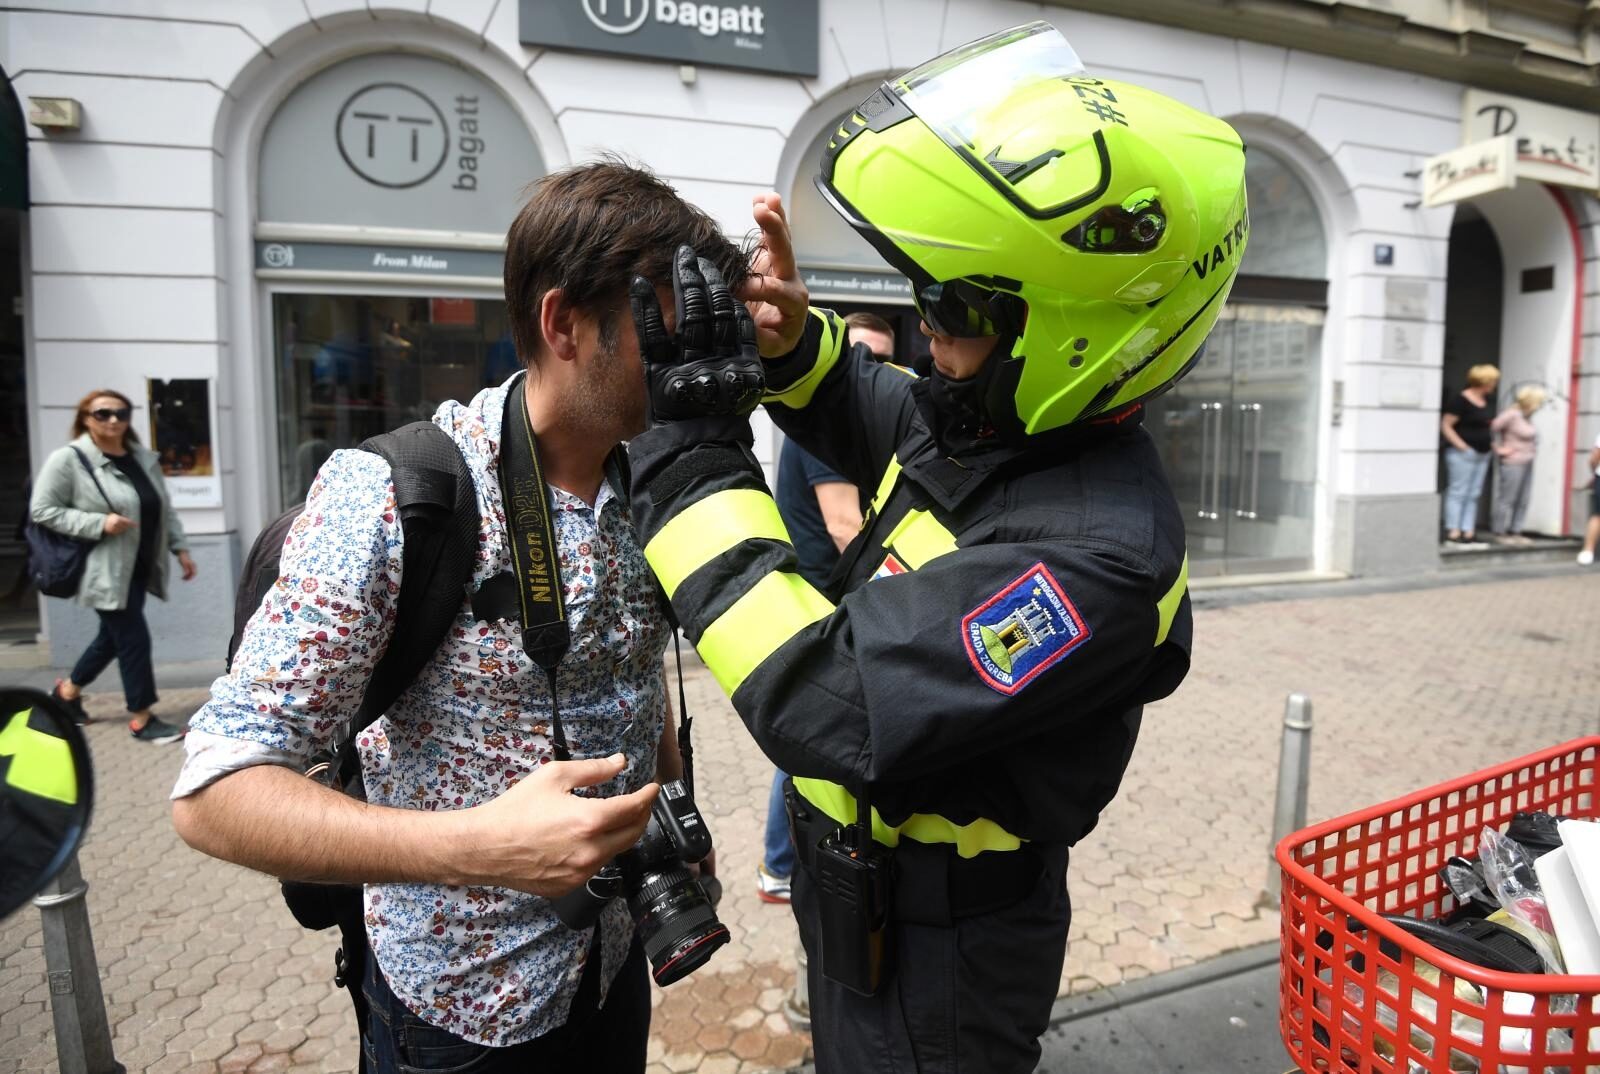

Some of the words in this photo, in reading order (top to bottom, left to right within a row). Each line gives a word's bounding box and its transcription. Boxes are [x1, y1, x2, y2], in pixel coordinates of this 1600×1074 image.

[655, 0, 765, 36] bagatt
[452, 95, 485, 191] bagatt
[372, 252, 408, 267] From
[409, 254, 448, 270] Milan
[833, 277, 860, 289] made
[861, 279, 882, 291] with
[526, 532, 552, 602] Nikon
[970, 622, 985, 654] GRADA
[980, 654, 1013, 685] ZAGREBA
